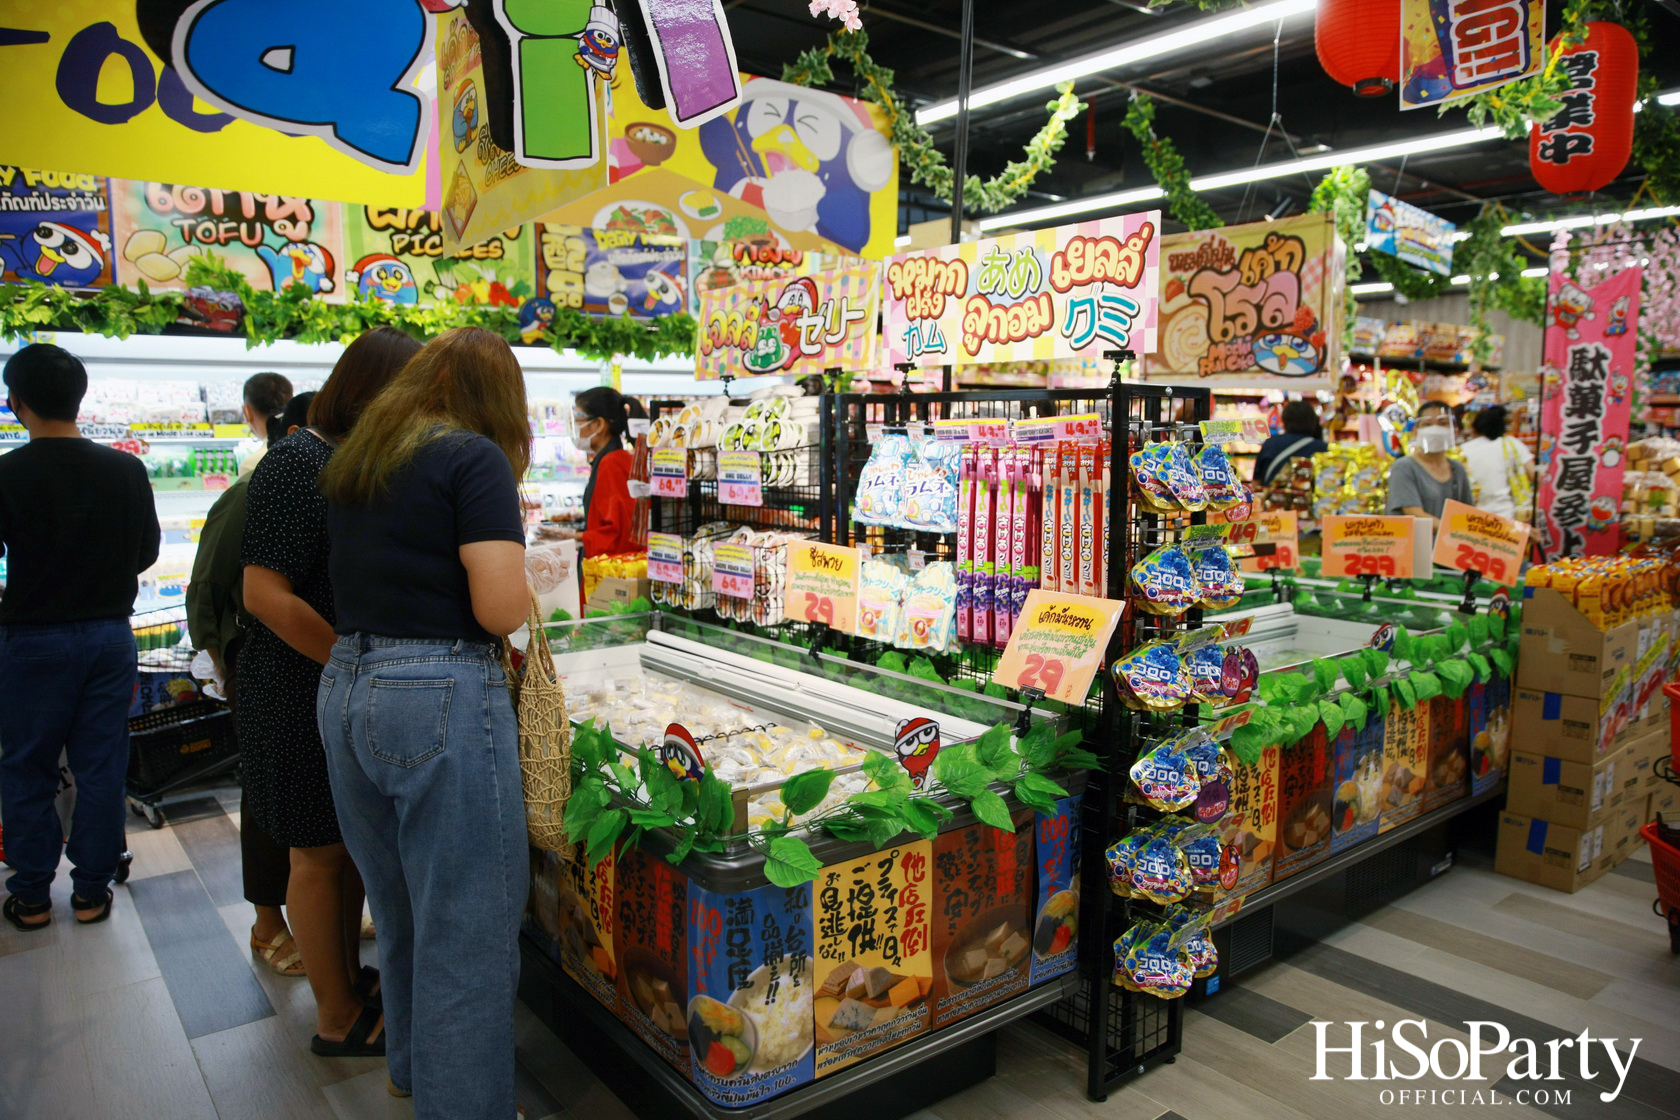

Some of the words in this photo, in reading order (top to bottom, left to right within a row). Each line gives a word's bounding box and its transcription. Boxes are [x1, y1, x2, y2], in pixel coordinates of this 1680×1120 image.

[170, 217, 265, 247] TOFU
[888, 257, 968, 300] หมาก
[977, 246, 1041, 299] あめ
[1239, 231, 1304, 287] เค้ก
[963, 295, 1054, 355] ลูกอม
[1188, 268, 1302, 344] โรล
[1344, 553, 1396, 576] 299
[1455, 543, 1506, 581] 299
[804, 592, 834, 627] 29
[1038, 604, 1094, 631] เค้กมันหวาน
[1017, 654, 1065, 695] 29
[899, 851, 928, 957] 他店圧倒
[725, 897, 755, 991] 満足度
